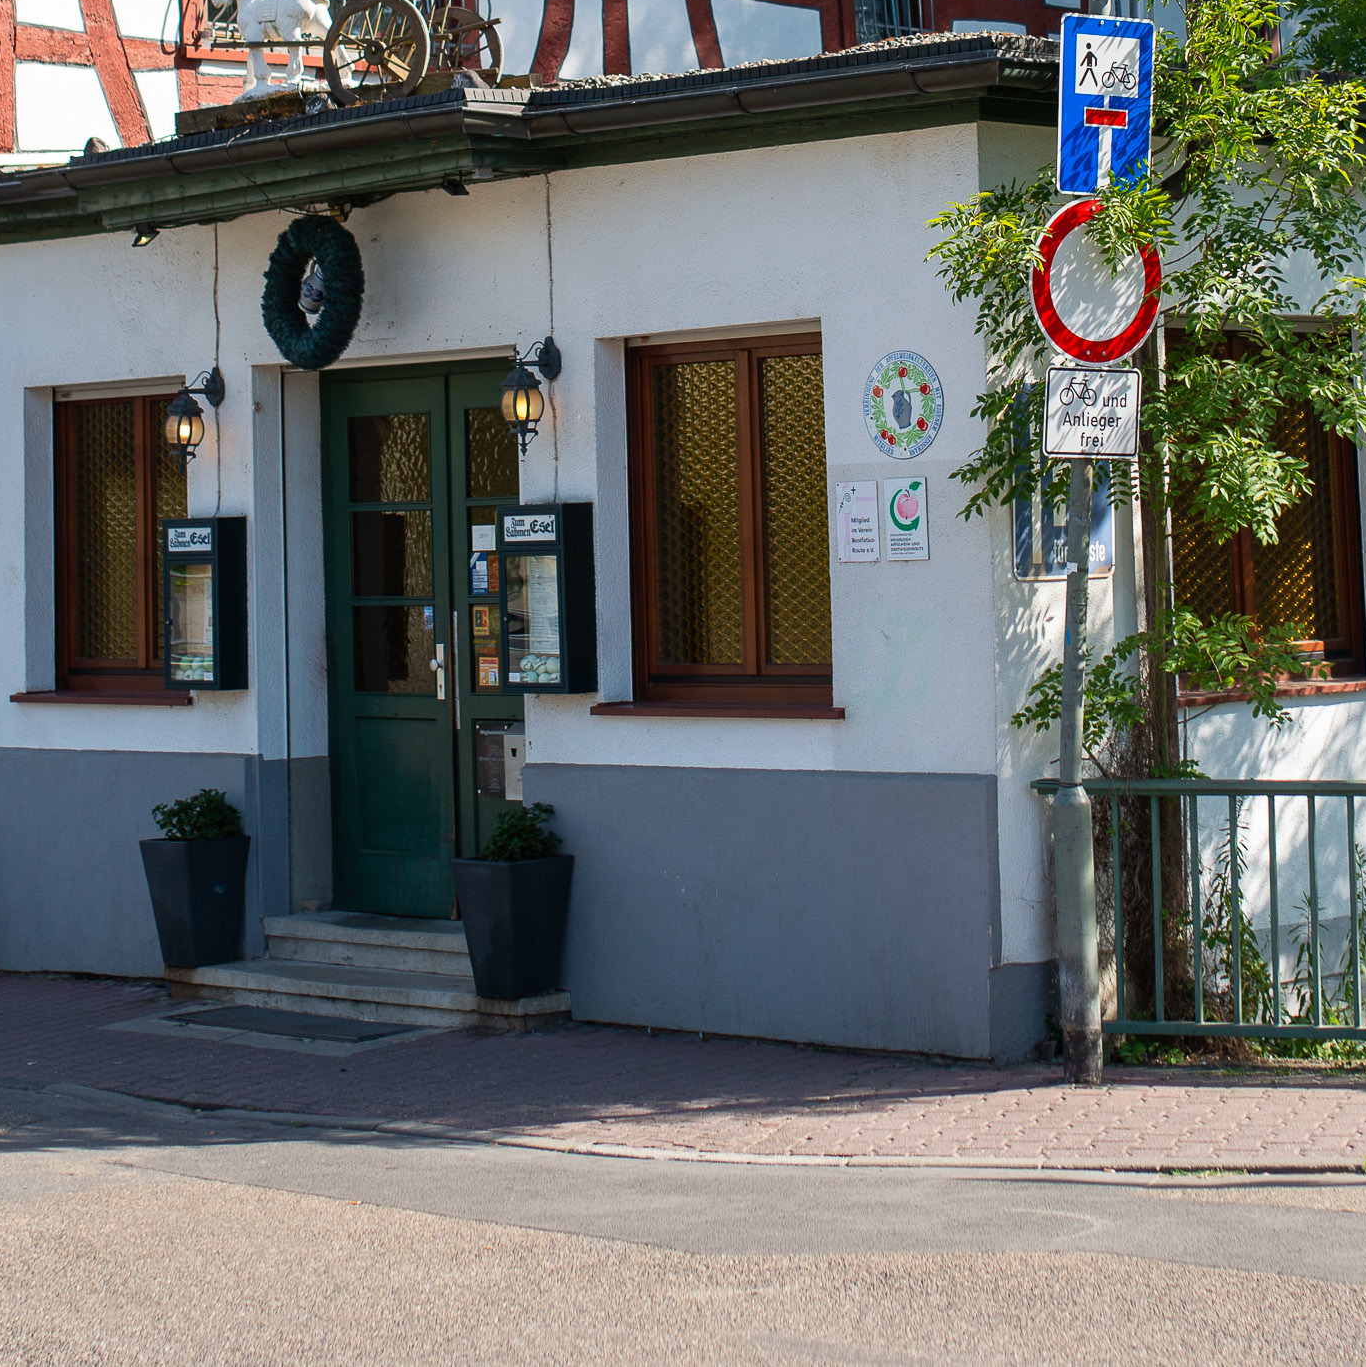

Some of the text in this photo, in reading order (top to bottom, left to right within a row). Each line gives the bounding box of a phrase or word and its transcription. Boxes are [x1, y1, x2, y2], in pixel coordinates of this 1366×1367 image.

[1102, 393, 1127, 407] und
[1062, 411, 1122, 431] Anlieger
[1080, 432, 1104, 447] frei
[530, 519, 555, 533] Esel
[1053, 539, 1069, 563] für
